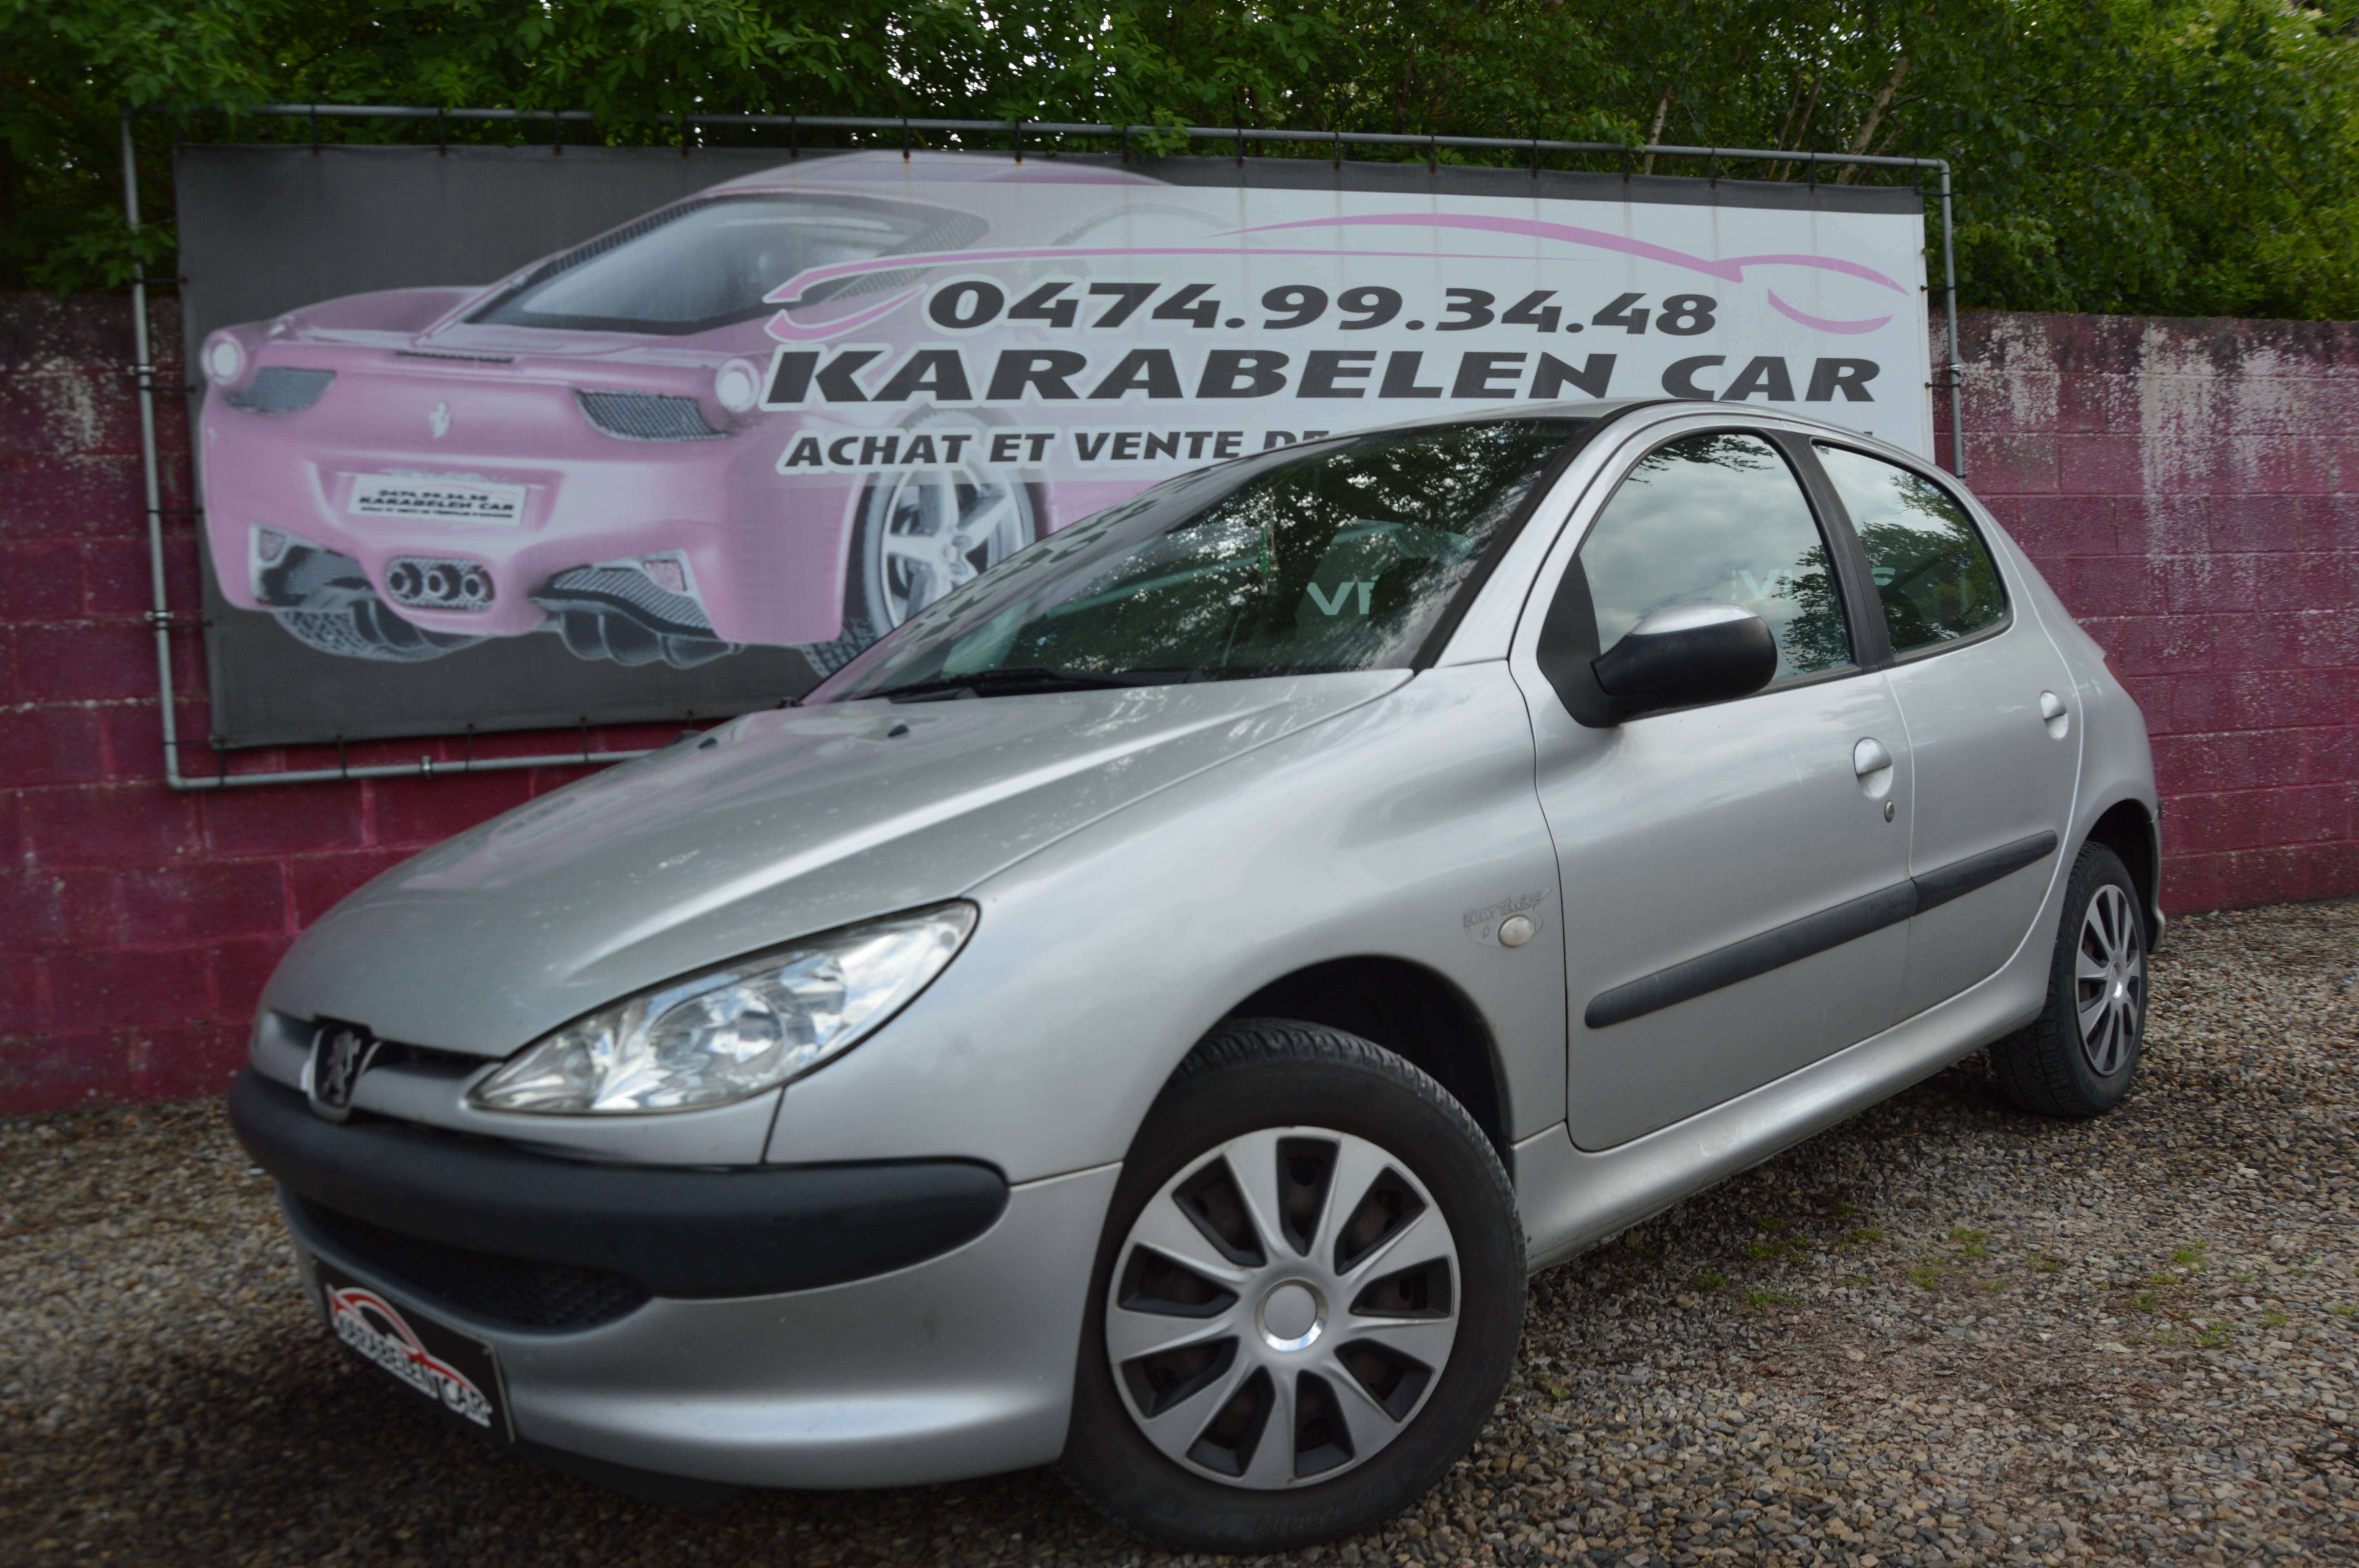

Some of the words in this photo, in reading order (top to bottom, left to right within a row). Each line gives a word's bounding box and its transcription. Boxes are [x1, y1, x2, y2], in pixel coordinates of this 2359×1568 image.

[929, 281, 1717, 336] 0474.99.34.48
[767, 349, 1617, 403] KARABELEN
[1661, 355, 1880, 402] CAR
[785, 435, 971, 466] ACHAT
[990, 434, 1054, 462] ET
[1075, 431, 1243, 461] VENTE
